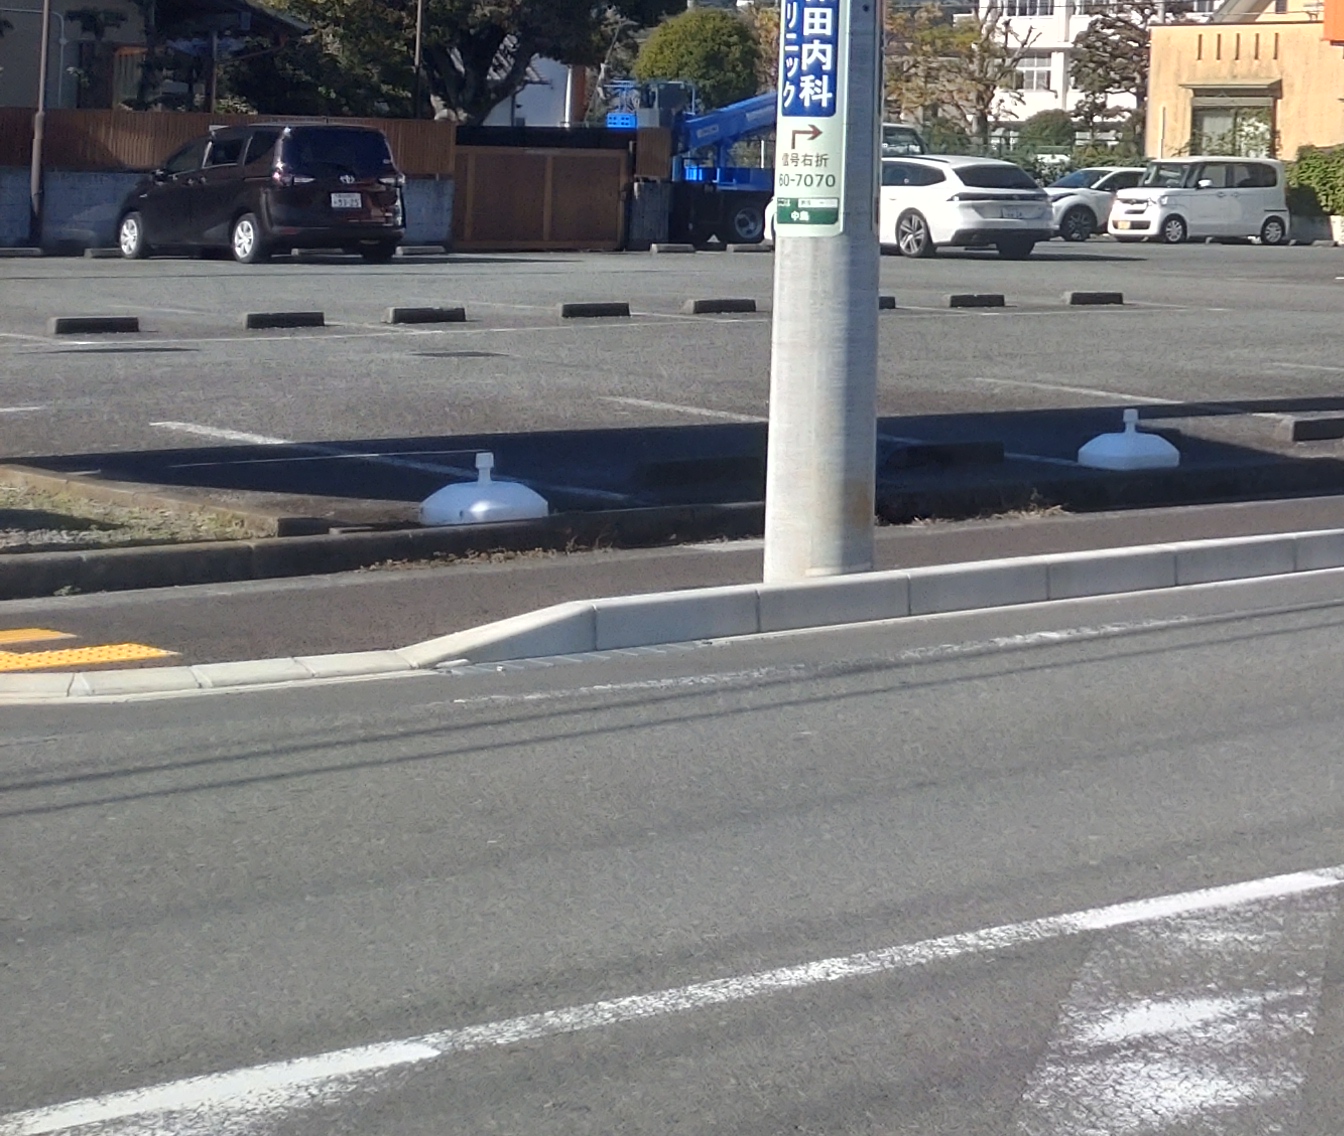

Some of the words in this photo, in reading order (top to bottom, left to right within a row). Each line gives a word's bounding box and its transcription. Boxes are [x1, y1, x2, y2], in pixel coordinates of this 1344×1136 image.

[782, 152, 830, 168] 信号右折
[779, 173, 836, 188] 60-7070
